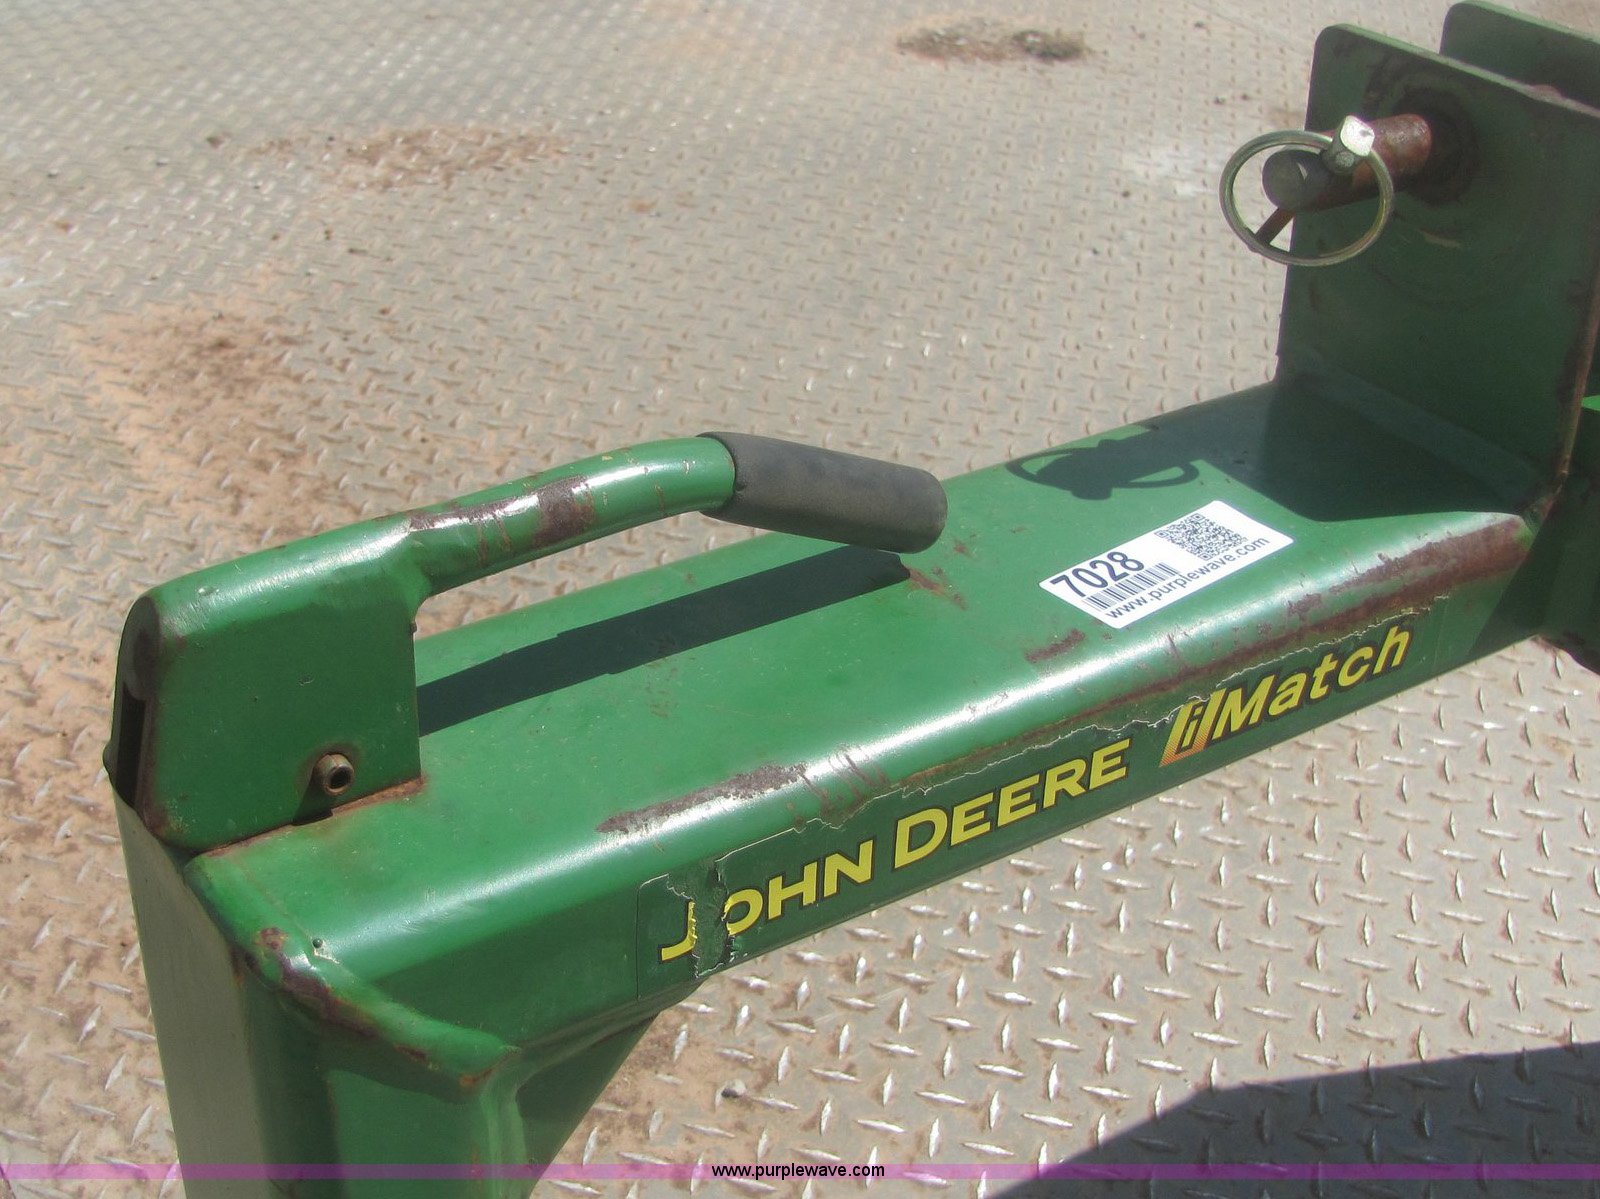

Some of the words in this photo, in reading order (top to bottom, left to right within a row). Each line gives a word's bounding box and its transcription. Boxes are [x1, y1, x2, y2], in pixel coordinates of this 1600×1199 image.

[1050, 551, 1145, 598] 7028
[1106, 537, 1270, 619] www.purplewave.com
[661, 839, 874, 962] JOHN
[894, 738, 1131, 869] DEERE
